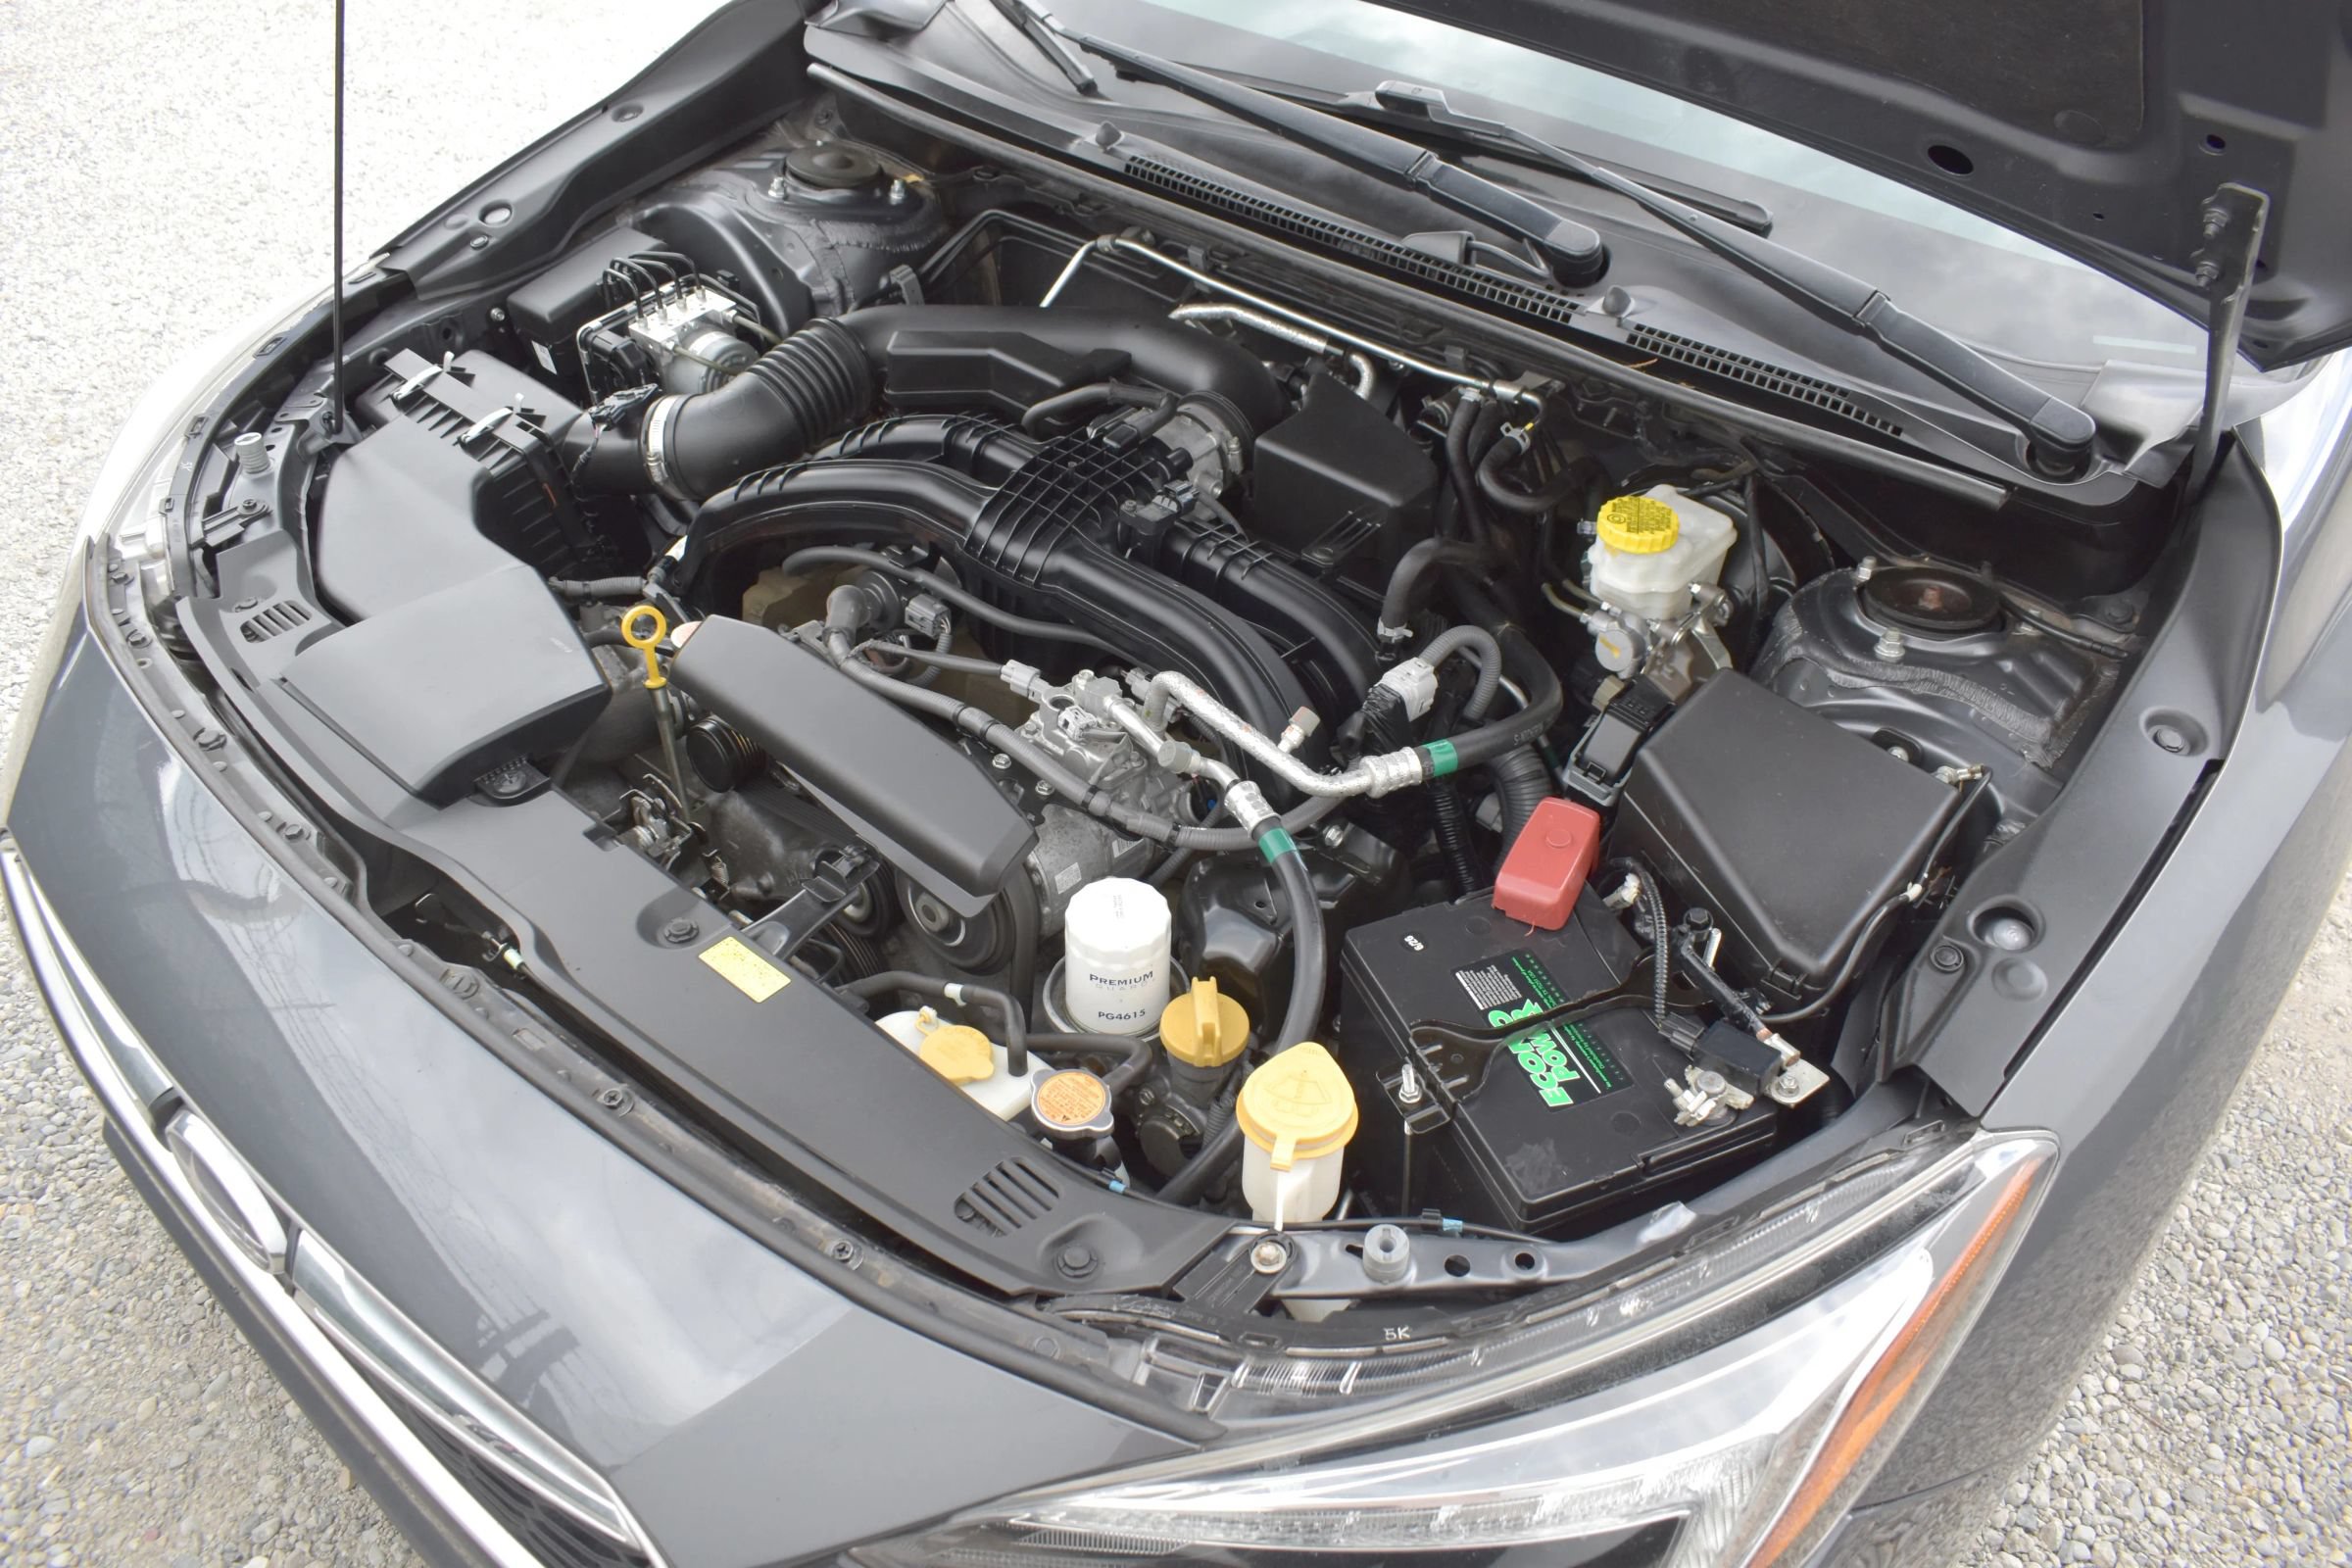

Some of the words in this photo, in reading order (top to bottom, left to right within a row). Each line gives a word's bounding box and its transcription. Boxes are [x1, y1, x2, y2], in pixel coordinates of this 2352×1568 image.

[1403, 934, 1424, 951] 6/26
[1089, 970, 1153, 986] PREMIUM
[1098, 1008, 1146, 1020] PG4615
[1510, 999, 1581, 1082] POWR
[1383, 1325, 1411, 1342] 5K
